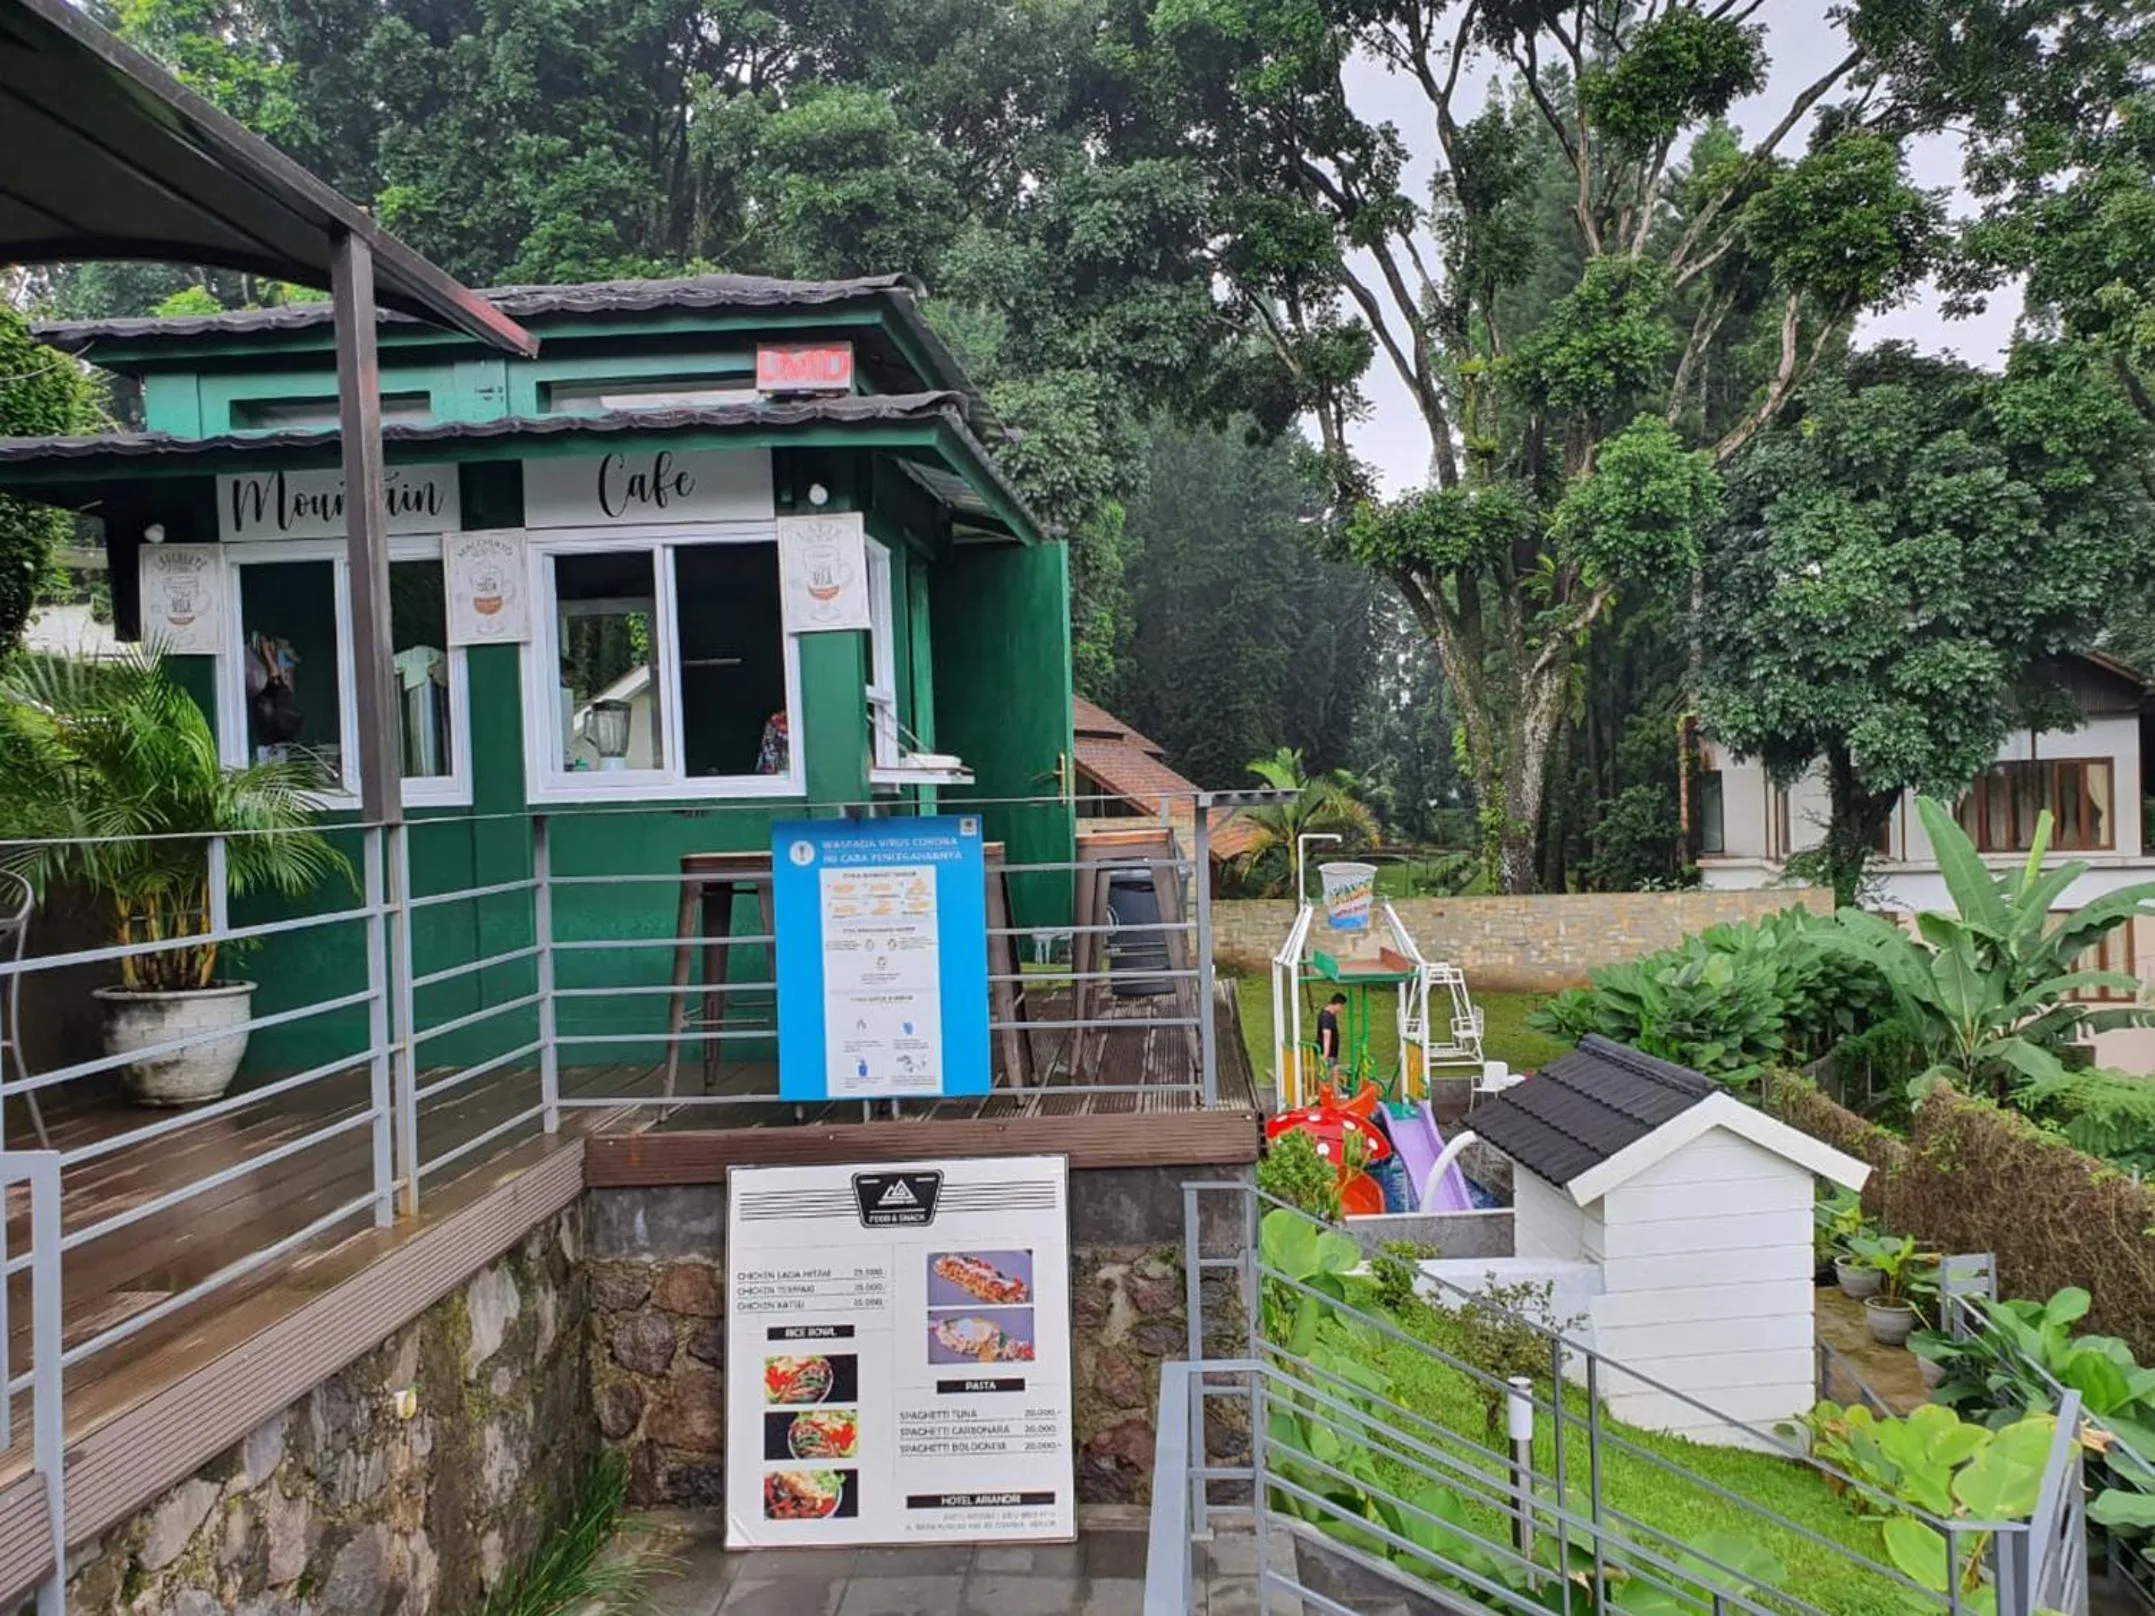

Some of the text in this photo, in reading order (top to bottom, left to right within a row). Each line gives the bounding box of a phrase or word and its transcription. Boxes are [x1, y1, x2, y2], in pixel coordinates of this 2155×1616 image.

[598, 450, 697, 518] Cafe
[232, 470, 445, 532] Mouain
[880, 838, 911, 849] VIRUS
[913, 836, 958, 847] CORONA
[785, 1328, 805, 1338] RICE
[965, 1382, 997, 1392] PASTA
[900, 1410, 977, 1420] SPAGHETTI TUNA
[900, 1427, 950, 1437] SPAGHETTI
[900, 1443, 950, 1453] SPAGHETTI
